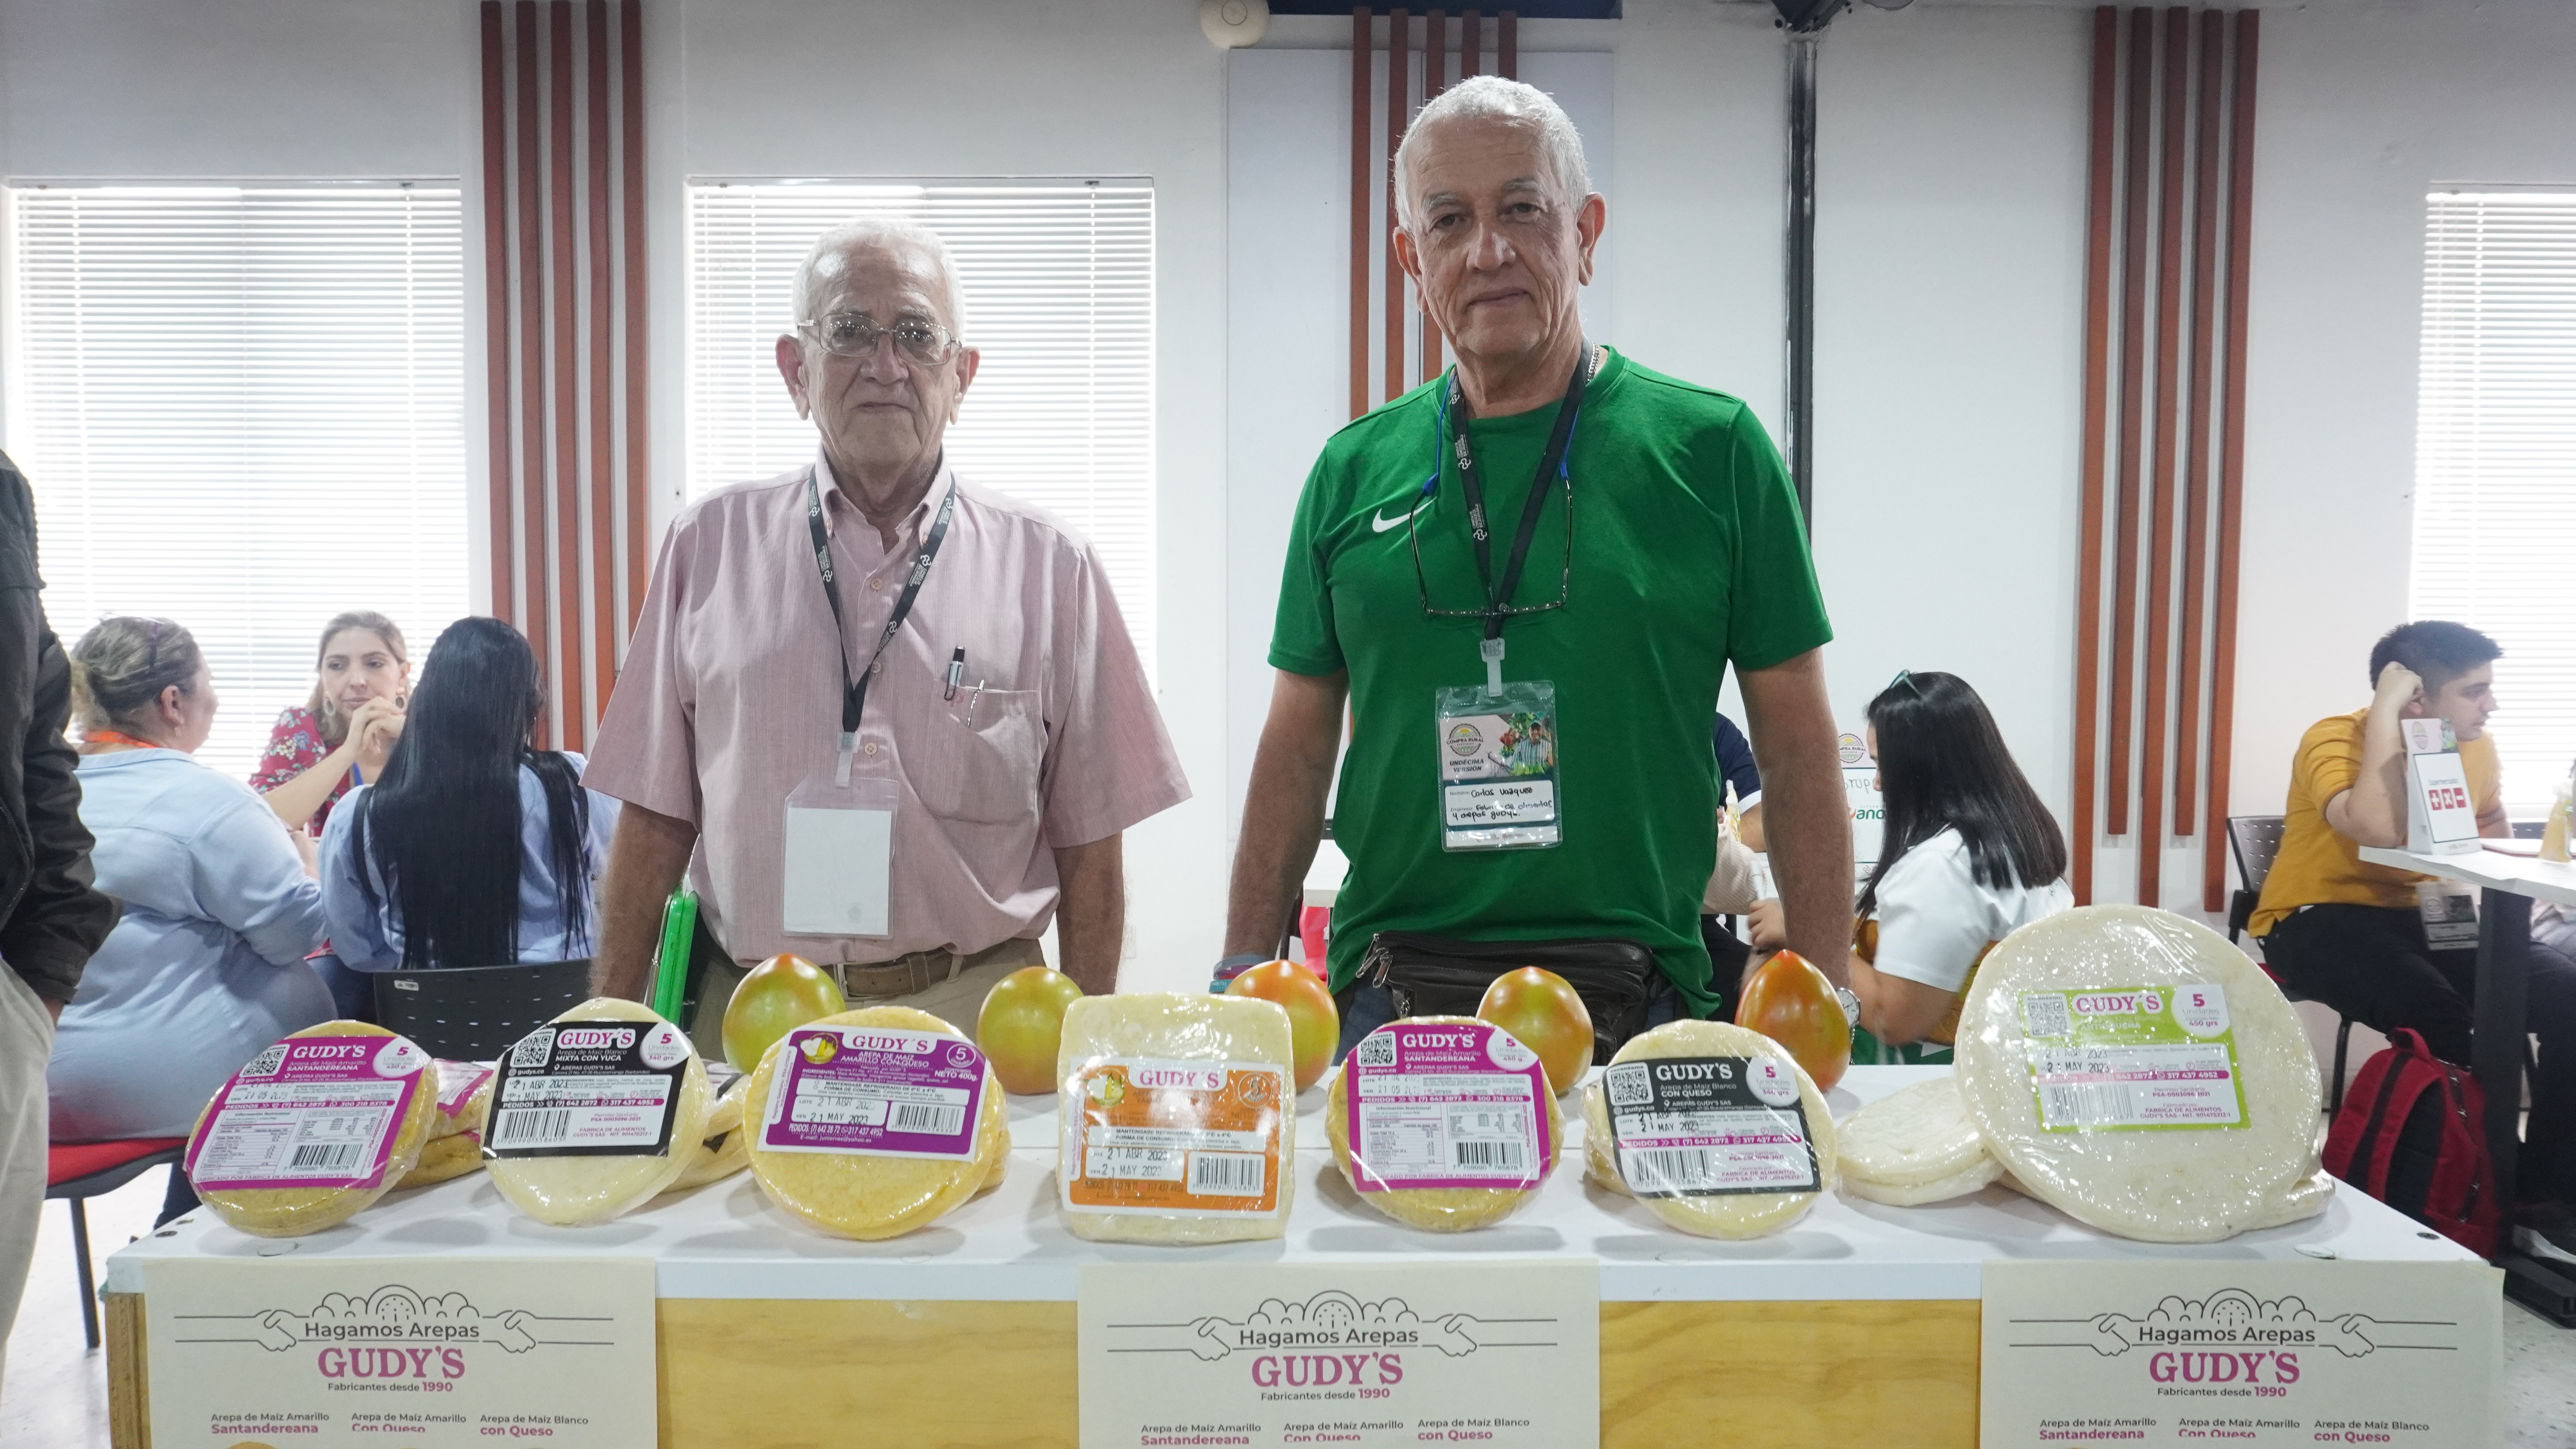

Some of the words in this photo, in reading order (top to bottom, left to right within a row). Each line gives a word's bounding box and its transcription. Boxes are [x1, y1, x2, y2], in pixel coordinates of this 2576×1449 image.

[1471, 788, 1494, 798] Carlos
[2193, 994, 2205, 1007] 5
[660, 1034, 672, 1044] 5
[1506, 1038, 1516, 1047] 5
[396, 1046, 410, 1056] 5
[955, 1047, 967, 1061] 5
[935, 1070, 957, 1079] NETO
[1656, 1063, 1732, 1081] GUDY'S
[1765, 1066, 1776, 1078] 5
[1250, 1077, 1261, 1095] 5
[1682, 1089, 1712, 1098] QUESO
[827, 1112, 844, 1122] MAY
[848, 1115, 869, 1125] 2023
[1658, 1123, 1674, 1132] MAY
[1126, 1147, 1143, 1159] ABR
[1120, 1164, 1137, 1176] MAY
[305, 1320, 403, 1341] Hagamos
[408, 1320, 480, 1341] Arepas
[2139, 1326, 2237, 1346] Hagamos
[2242, 1326, 2316, 1345] Arepas
[1239, 1328, 1340, 1348] Hagamos
[1345, 1328, 1419, 1347] Arepas
[317, 1346, 466, 1380] GUDY'S
[2149, 1349, 2300, 1384] GUDY'S
[1251, 1352, 1404, 1388] GUDY'S
[328, 1382, 387, 1392] Fabricantes
[389, 1382, 420, 1391] desde
[422, 1381, 453, 1392] 1990
[2157, 1387, 2218, 1397] Fabricantes
[2220, 1387, 2252, 1397] desde
[2254, 1386, 2287, 1398] 1990
[1261, 1391, 1322, 1401] Fabricantes
[1324, 1391, 1356, 1400] desde
[1357, 1388, 1391, 1399] 1990
[211, 1413, 242, 1422] Arepa
[244, 1413, 258, 1422] de
[260, 1413, 284, 1422] Maíz
[286, 1413, 330, 1421] Amarillo
[351, 1413, 381, 1422] Arepa
[384, 1413, 397, 1422] de
[399, 1413, 422, 1422] Maíz
[424, 1414, 467, 1423] Amarillo
[480, 1414, 511, 1425] Arepa
[514, 1414, 526, 1424] de
[529, 1414, 553, 1424] Maíz
[555, 1415, 589, 1425] Blanco
[1417, 1419, 1449, 1429] Arepa
[1451, 1419, 1464, 1428] de
[1467, 1418, 1491, 1428] Maíz
[1494, 1417, 1530, 1427] Blanco
[2039, 1419, 2071, 1428] Arepa
[2072, 1419, 2086, 1427] de
[2088, 1419, 2112, 1428] Maíz
[2114, 1418, 2157, 1427] Amarillo
[2178, 1418, 2210, 1428] Arepa
[2212, 1418, 2226, 1427] de
[2229, 1418, 2253, 1428] Maíz
[2255, 1419, 2300, 1428] Amarillo
[211, 1423, 319, 1434] Santandereana
[480, 1427, 506, 1436] con
[509, 1425, 553, 1437] Queso
[1141, 1423, 1173, 1434] Arepa
[1175, 1423, 1188, 1432] de
[1191, 1423, 1215, 1433] Maíz
[1217, 1423, 1261, 1433] Amarillo
[1284, 1422, 1315, 1432] Arepa
[1317, 1422, 1331, 1431] de
[1333, 1421, 1358, 1431] Maíz
[1360, 1420, 1404, 1430] Amarillo
[2315, 1420, 2346, 1431] Arepa
[2348, 1420, 2361, 1429] de
[2363, 1420, 2388, 1430] Maíz
[2391, 1421, 2430, 1431] Blanco
[1141, 1434, 1250, 1446] Santandereana
[1417, 1431, 1445, 1441] con
[1448, 1429, 1493, 1443] Queso
[2039, 1428, 2145, 1440] Santandereana
[2314, 1432, 2342, 1443] con
[2344, 1431, 2391, 1444] Queso
